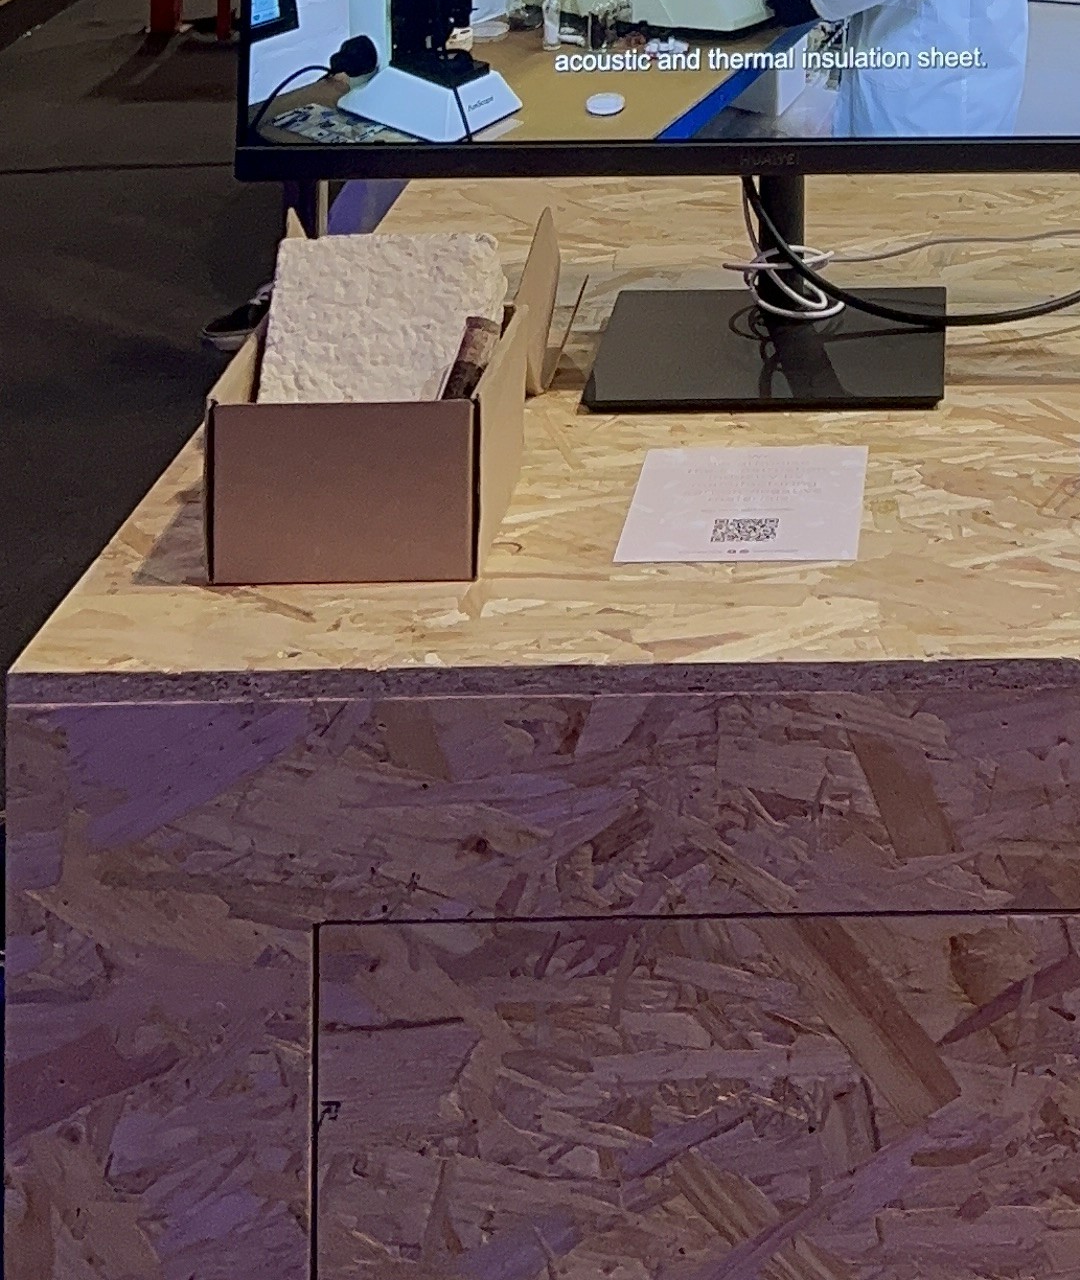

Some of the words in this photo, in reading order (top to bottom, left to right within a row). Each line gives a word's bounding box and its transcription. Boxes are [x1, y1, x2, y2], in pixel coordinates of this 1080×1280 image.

[555, 51, 651, 71] acoustic
[657, 49, 701, 70] and
[708, 48, 795, 70] thermal
[801, 47, 909, 69] insulation
[916, 46, 987, 69] sheet.
